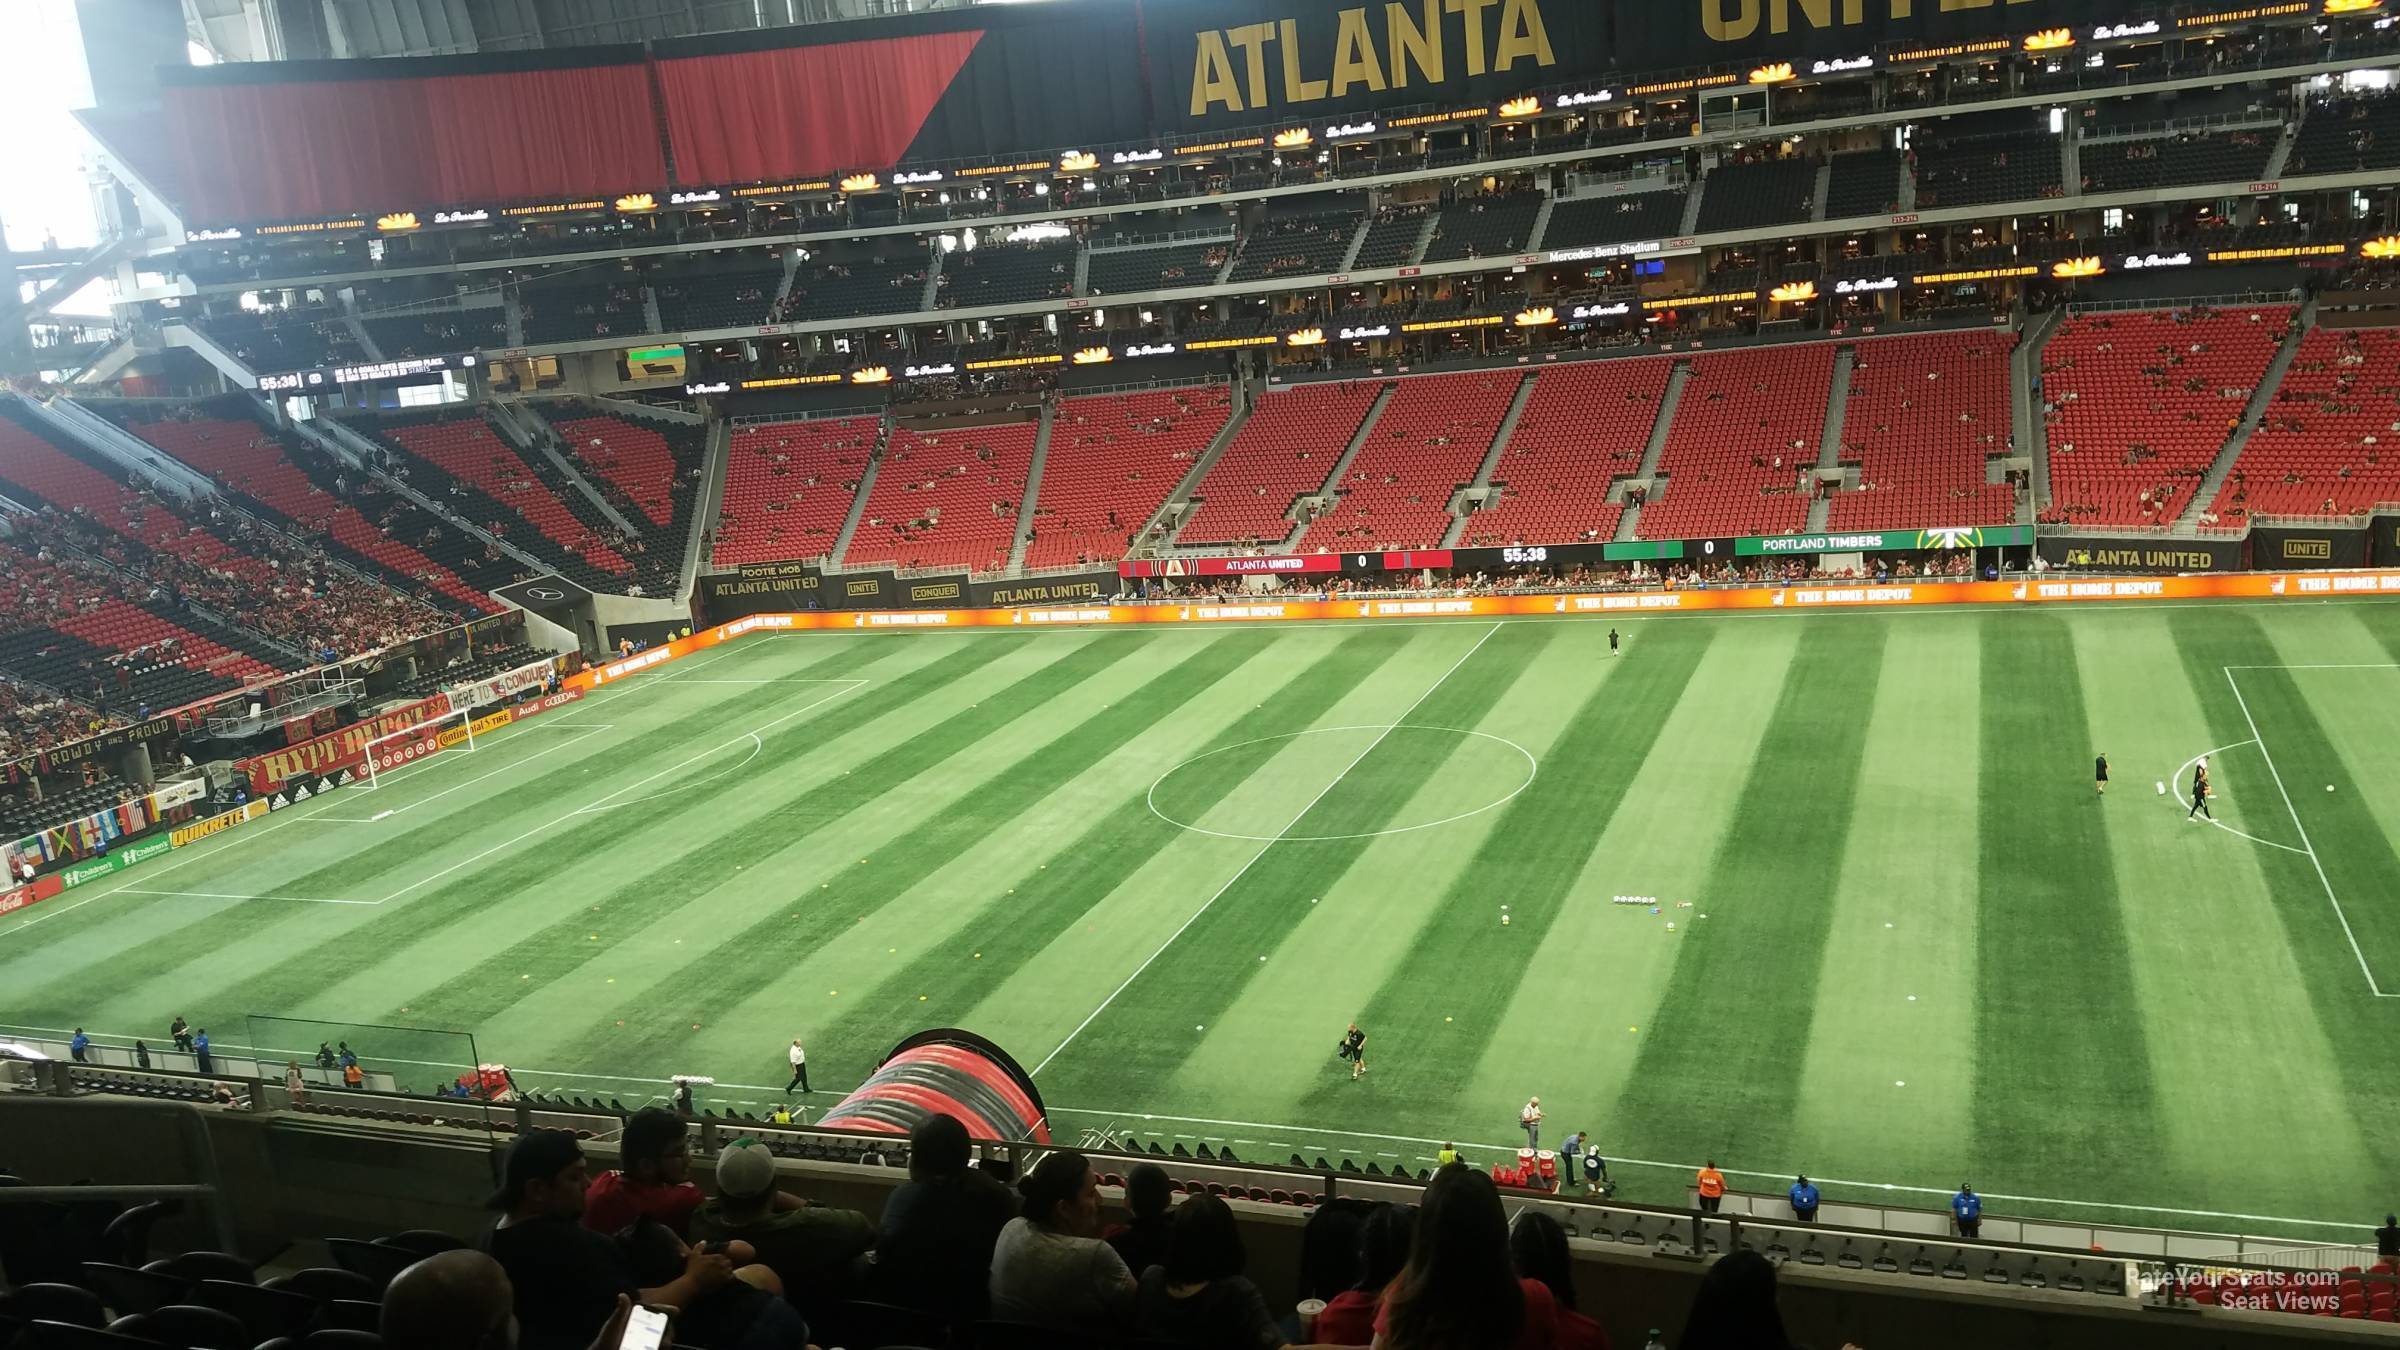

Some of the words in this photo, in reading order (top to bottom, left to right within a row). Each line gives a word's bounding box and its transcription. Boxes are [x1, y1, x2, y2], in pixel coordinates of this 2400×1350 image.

[2093, 27, 2112, 39] La
[1190, 0, 1556, 116] ATLANTA
[1813, 61, 1830, 73] La
[1557, 95, 1573, 106] La
[1550, 247, 1618, 262] Mercedes-Benz
[1620, 242, 1660, 255] Stadium
[2124, 256, 2143, 268] La
[1836, 281, 1854, 292] La
[260, 375, 297, 390] 55:38
[687, 385, 694, 394] a
[1705, 541, 1714, 554] 0
[1762, 537, 1825, 551] PORTLAND
[1828, 535, 1883, 549] TIMBERS
[2288, 543, 2326, 555] UNITE
[1358, 555, 1367, 567] 0
[1503, 548, 1547, 563] 55:38
[2145, 551, 2212, 568] UNITED
[742, 567, 777, 577] FOOTIE
[779, 565, 801, 575] MOB
[1226, 561, 1267, 571] ATLANTA
[1268, 558, 1303, 569] UNITED
[716, 581, 770, 596] ATLANTA
[772, 577, 818, 592] UNITED
[850, 583, 876, 593] UNITE
[2038, 584, 2068, 596] THE
[2071, 583, 2112, 596] HOME
[2115, 581, 2163, 595] DEPOT
[2298, 578, 2330, 592] THE
[2334, 576, 2378, 590] HOME
[914, 586, 956, 598] CONQUER
[993, 587, 1049, 603] ATLANTA
[1051, 582, 1099, 598] UNITED
[1795, 591, 1823, 602] THE
[1826, 590, 1864, 602] HOME
[1867, 588, 1912, 600] DEPOT
[1575, 597, 1600, 609] THE
[1603, 596, 1638, 608] HOME
[1640, 595, 1681, 606] DEPOT
[451, 689, 475, 710] HERE
[477, 684, 490, 700] TO
[505, 663, 550, 690] CONQUER
[519, 702, 539, 716] Audi
[492, 713, 509, 726] TIRE
[51, 740, 102, 767] ROWDY
[128, 720, 169, 741] PROUD
[264, 737, 341, 784] HYPE
[173, 807, 244, 846] QUIKRETE
[136, 840, 169, 857] Children's
[79, 862, 113, 878] Children's
